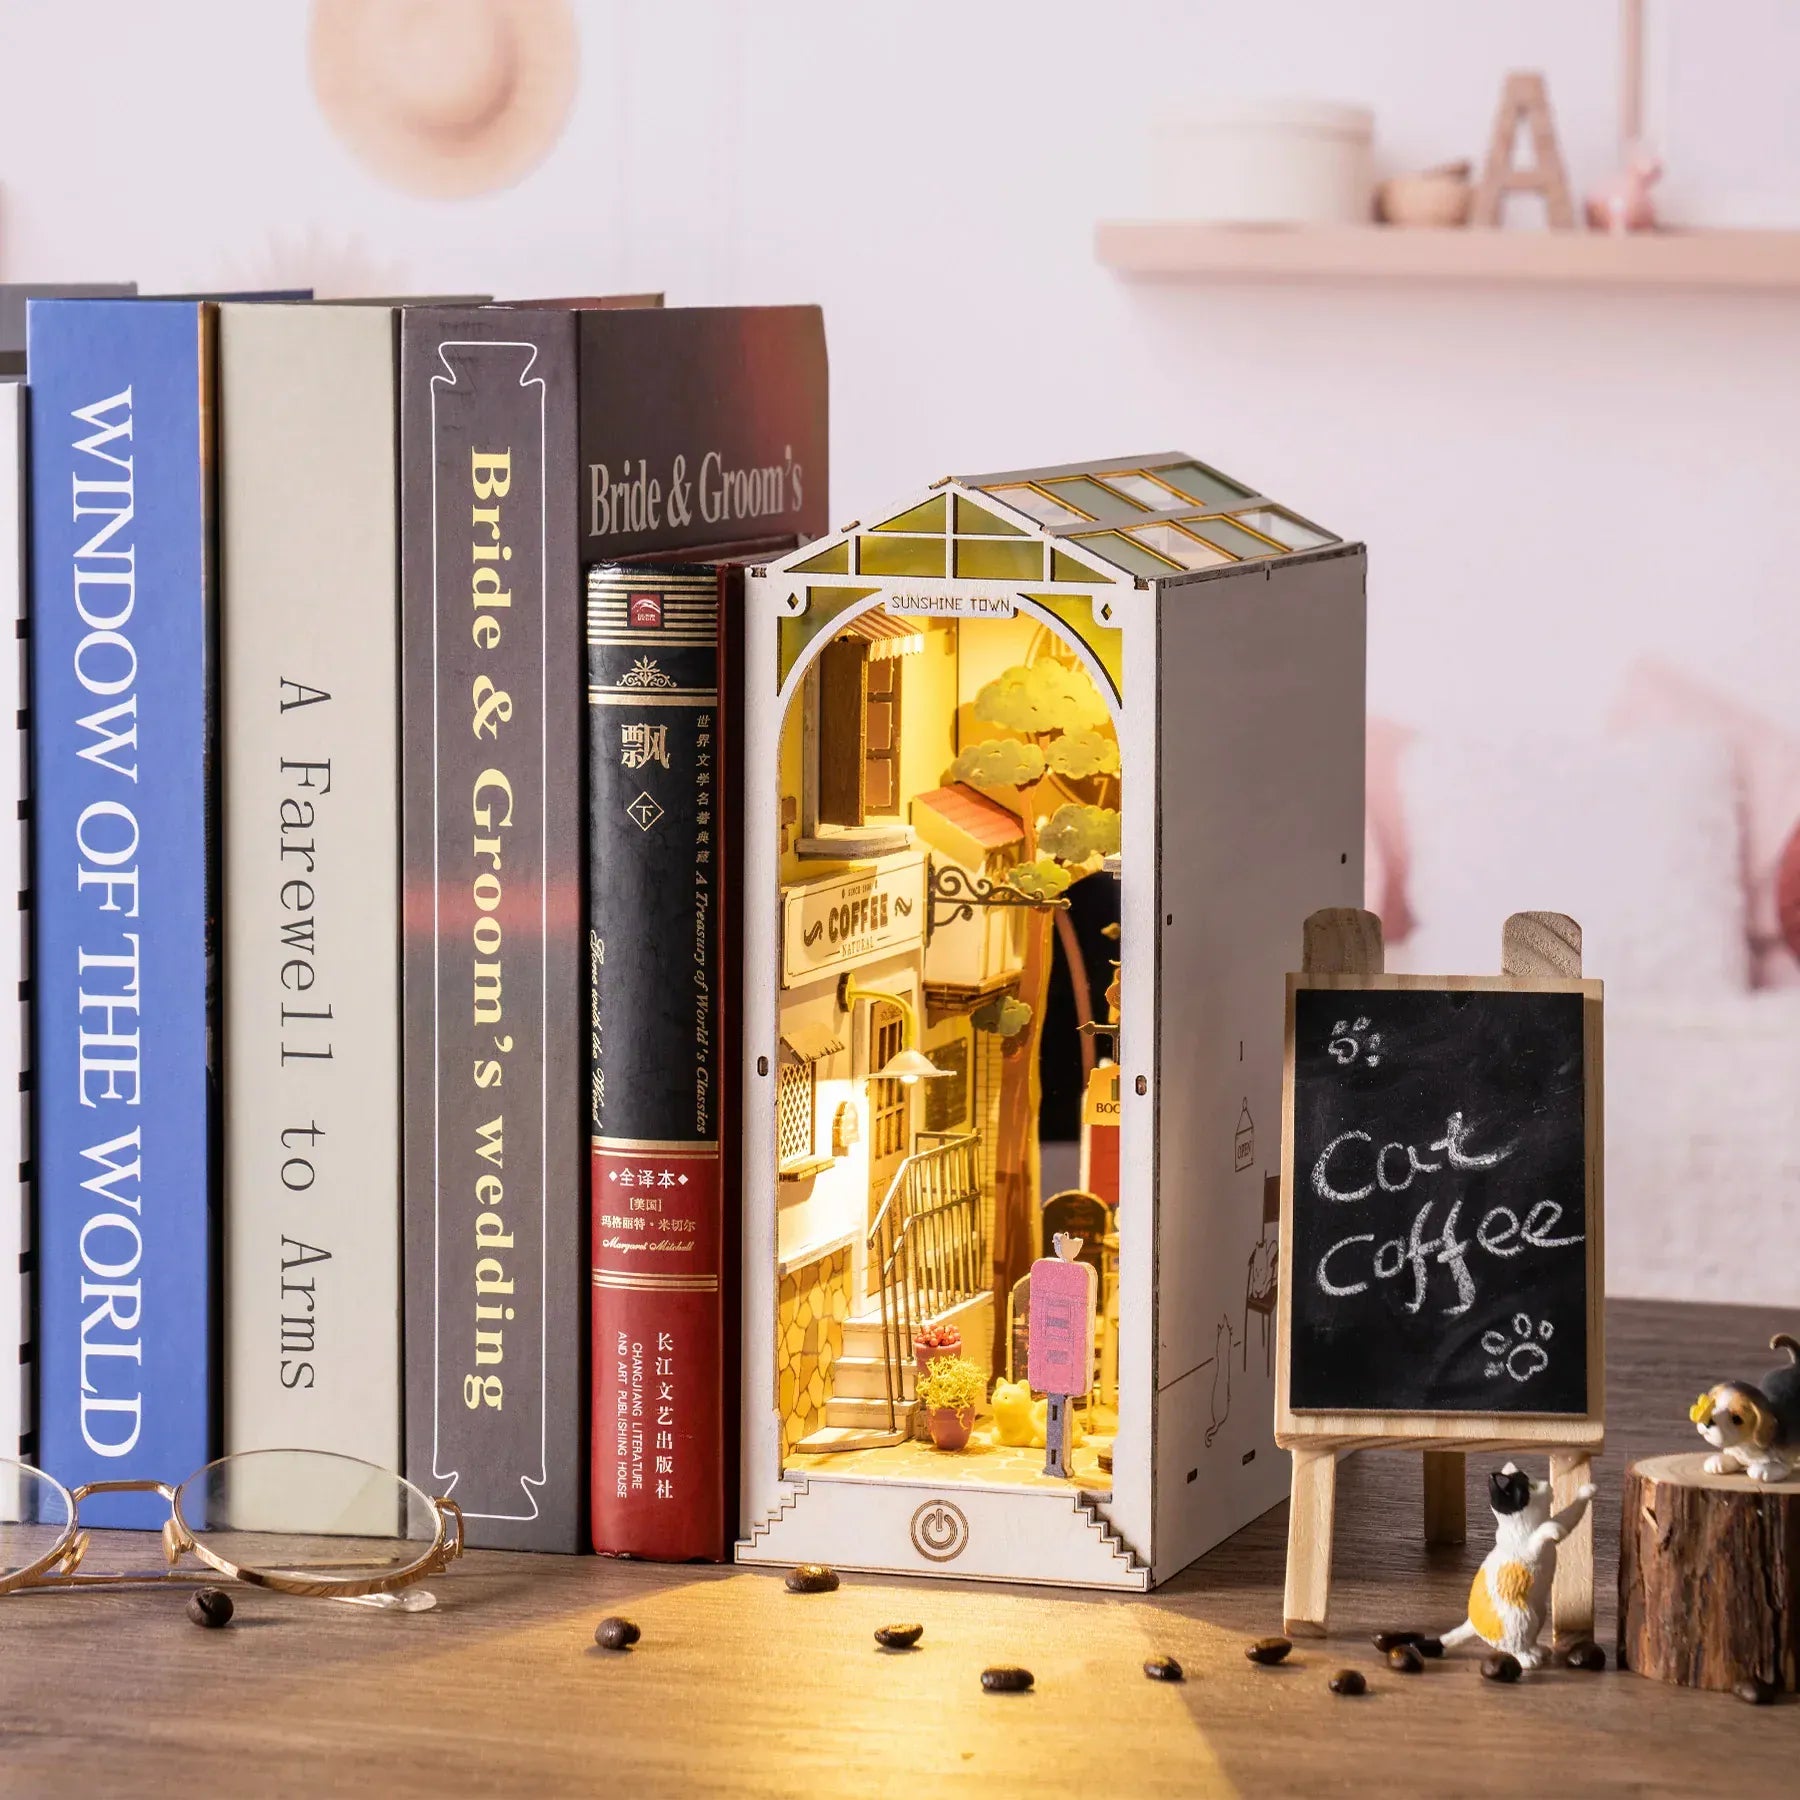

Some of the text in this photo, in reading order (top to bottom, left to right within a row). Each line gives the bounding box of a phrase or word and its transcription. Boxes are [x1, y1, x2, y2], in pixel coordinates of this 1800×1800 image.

[1470, 69, 1575, 230] A
[588, 444, 803, 537] Bride & Groom's
[891, 595, 1010, 612] SUNSHINE TOWN
[620, 722, 671, 769] 飘
[635, 804, 654, 824] 下
[695, 714, 711, 864] 世界文学名著典藏
[695, 870, 708, 885] A
[828, 892, 888, 943] COFFEE
[70, 385, 143, 1458] WINDOW OF THE WORLD
[464, 447, 515, 1411] Bride & Groom's wedding
[693, 892, 709, 966] Treasury
[693, 969, 709, 992] of
[280, 676, 334, 1389] A Farewell to Arms
[695, 1067, 709, 1134] Classics
[619, 1167, 676, 1189] 全译本
[1312, 1111, 1515, 1201] Cat
[602, 1237, 695, 1254] Margaret Mitchell
[616, 1331, 628, 1499] AND ART PUBLISHING HOUSE
[631, 1342, 643, 1490] CHANGJIANG LITERATURE
[655, 1332, 674, 1499] 长江文艺出版社
